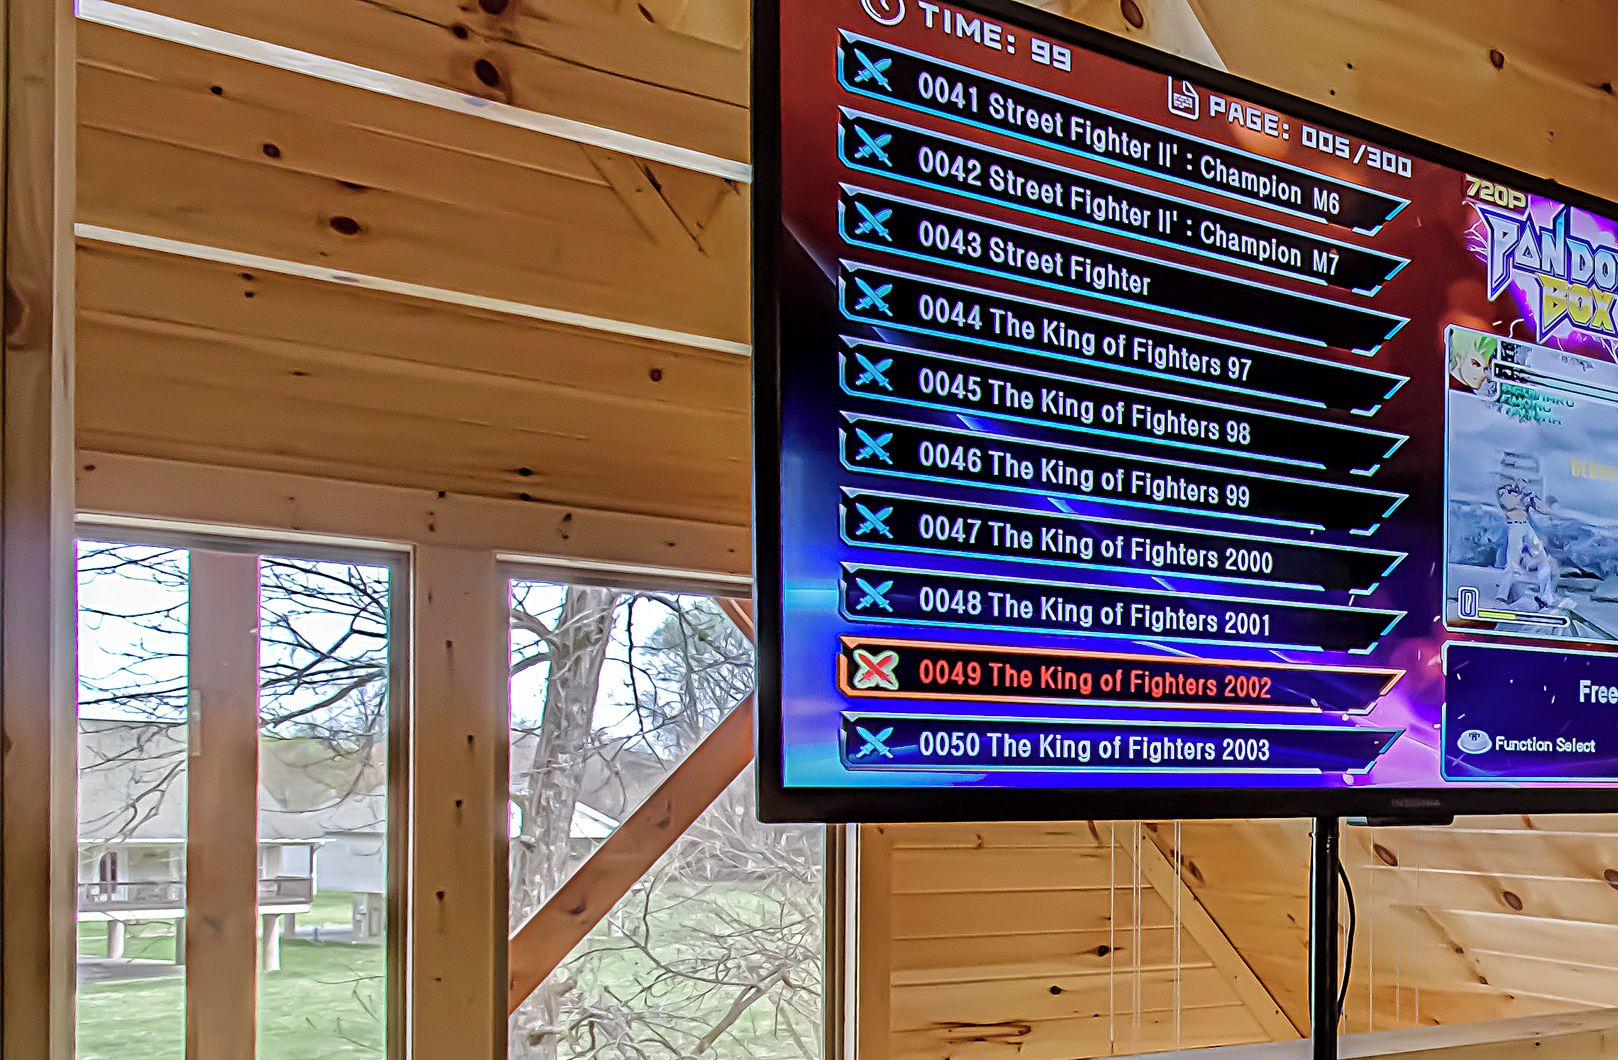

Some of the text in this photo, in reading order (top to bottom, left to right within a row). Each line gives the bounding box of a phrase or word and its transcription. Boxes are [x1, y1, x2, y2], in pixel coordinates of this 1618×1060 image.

[917, 1, 1072, 72] TIME: 99
[918, 72, 978, 113] 0041
[988, 92, 1064, 137] Street
[1071, 116, 1152, 162] Fighter
[1158, 141, 1178, 168] II'
[1200, 155, 1302, 205] Champion
[1313, 187, 1340, 215] M6
[1209, 95, 1412, 178] PAGE: 005/300
[919, 146, 982, 187] 0042
[989, 165, 1064, 207] Street
[1071, 185, 1151, 230] Fighter
[1158, 208, 1178, 234] II'
[1200, 220, 1301, 267] Champion
[1313, 249, 1340, 276] M7
[1465, 176, 1527, 209] 720P
[919, 220, 1151, 297] 0043 Street Fighter
[919, 294, 1252, 381] 0044 The King of Fighters 97
[1536, 272, 1617, 337] BOX
[918, 367, 1251, 445] 0045 The King of Fighters 98
[918, 441, 1250, 508] 0046 The King of Fighters 99
[919, 514, 1273, 574] 0047 The King of Fighters 2000
[919, 586, 1270, 636] 0048 The King of Fighters 2001
[919, 658, 1272, 699] 0049 The King of Fighters 2002
[1579, 679, 1618, 704] Free
[919, 731, 1270, 764] 0050 The King of Fighters 2003
[1495, 736, 1596, 752] Function Select
